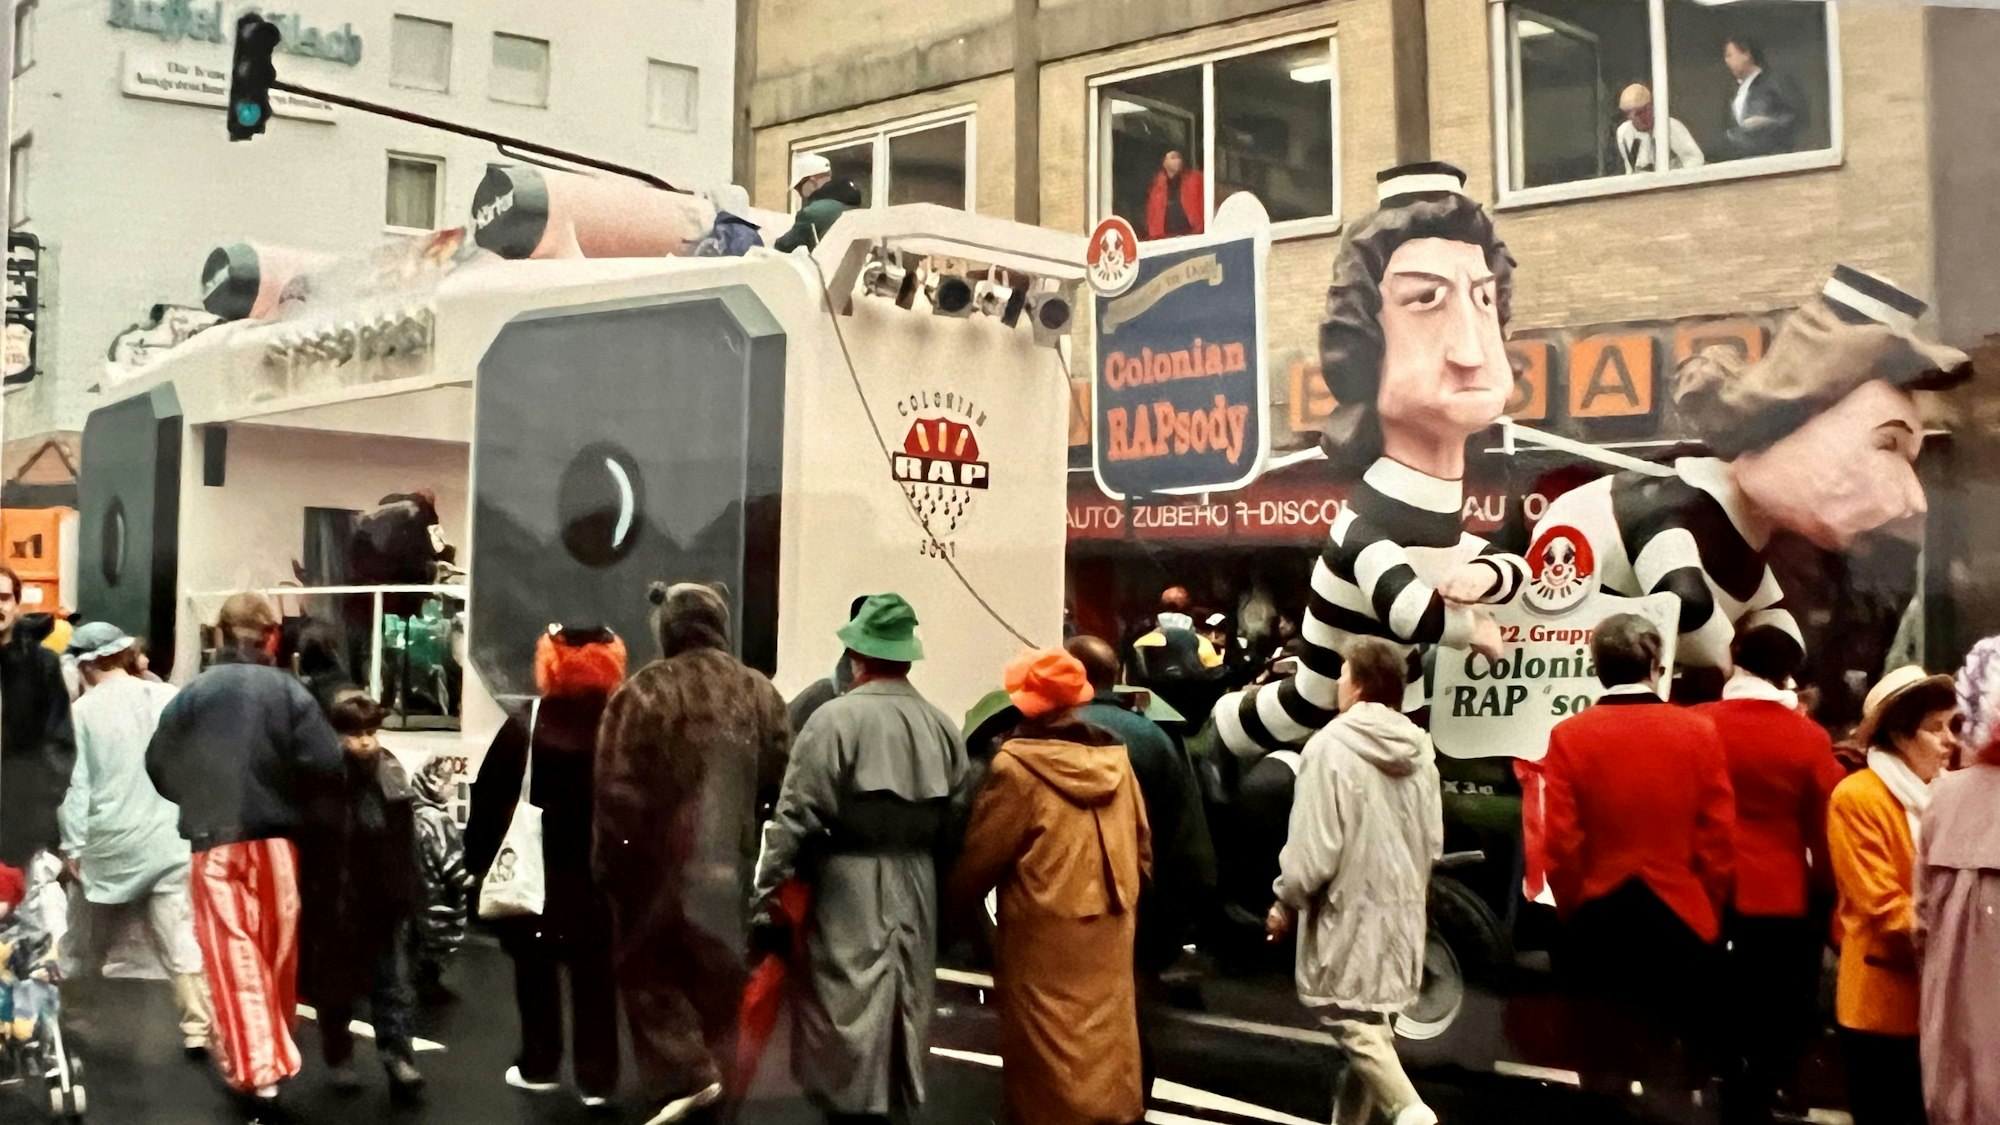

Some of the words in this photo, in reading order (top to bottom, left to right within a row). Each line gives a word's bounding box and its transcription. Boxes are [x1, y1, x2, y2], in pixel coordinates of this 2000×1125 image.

[1105, 338, 1246, 390] Colonian
[897, 391, 987, 427] COLONIAN
[1107, 394, 1249, 465] RAPsody
[895, 456, 986, 485] RAP
